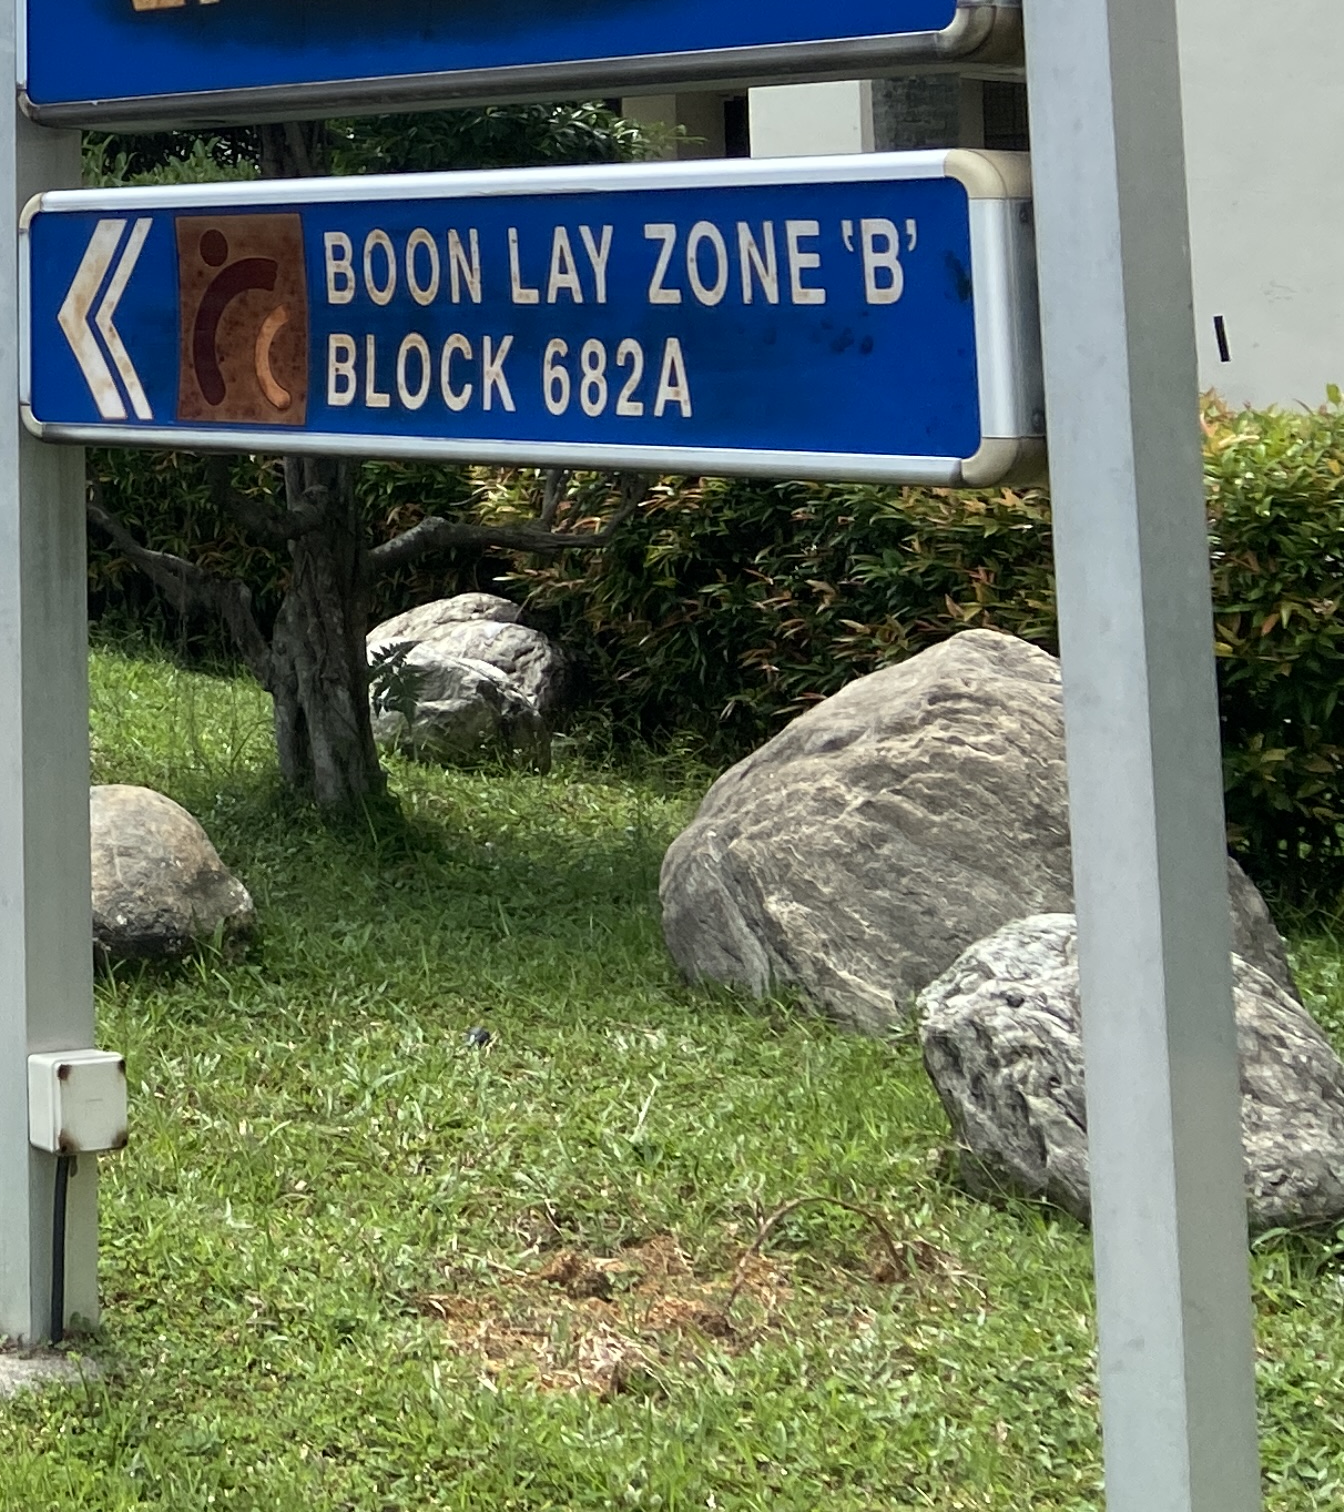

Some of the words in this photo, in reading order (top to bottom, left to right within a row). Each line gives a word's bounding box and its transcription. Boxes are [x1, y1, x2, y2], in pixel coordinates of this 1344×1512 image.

[323, 227, 483, 306] BOON
[508, 224, 614, 305] LAY
[644, 220, 827, 306] ZONE
[327, 332, 517, 413] BLOCK
[543, 337, 693, 418] 682A
